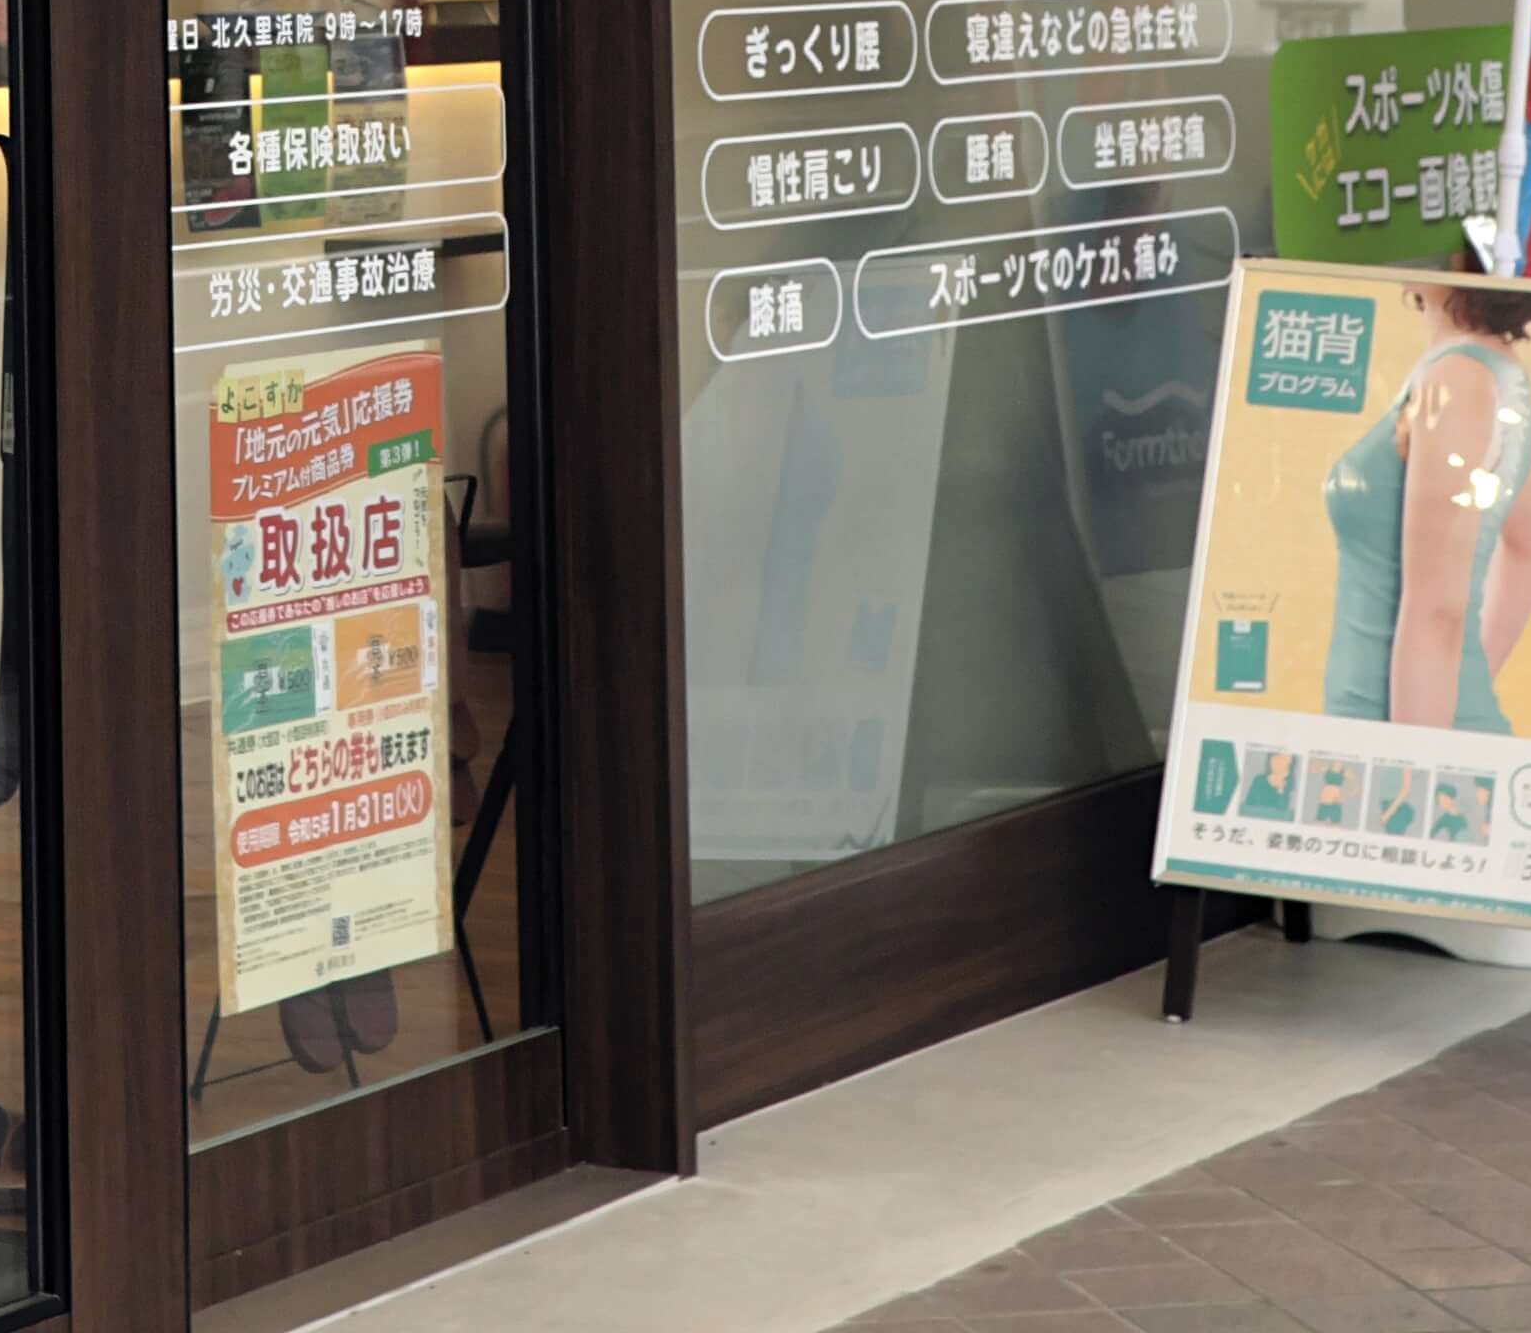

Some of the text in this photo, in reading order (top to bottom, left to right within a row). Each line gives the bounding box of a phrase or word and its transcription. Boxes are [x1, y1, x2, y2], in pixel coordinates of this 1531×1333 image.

[211, 12, 315, 47] 北久里浜院
[966, 2, 1200, 65] 寝違えなどの急性症状
[229, 121, 411, 176] 各種保険取扱い
[966, 131, 1016, 184] 腰痛
[1093, 113, 1206, 170] 坐骨神経痛
[747, 144, 882, 208] 慢性肩こり
[209, 248, 436, 318] 労災・交通事故治療
[928, 231, 1180, 311] スポーツでのケガ、痛み
[749, 280, 804, 338] 膝痛
[1261, 308, 1365, 367] 猫背
[220, 377, 304, 415] よこすか
[1257, 371, 1357, 401] プログラム
[235, 377, 414, 465] 「地元の元気」応援券
[232, 443, 356, 502] プレミアム付商品券
[259, 494, 402, 590] 取扱店
